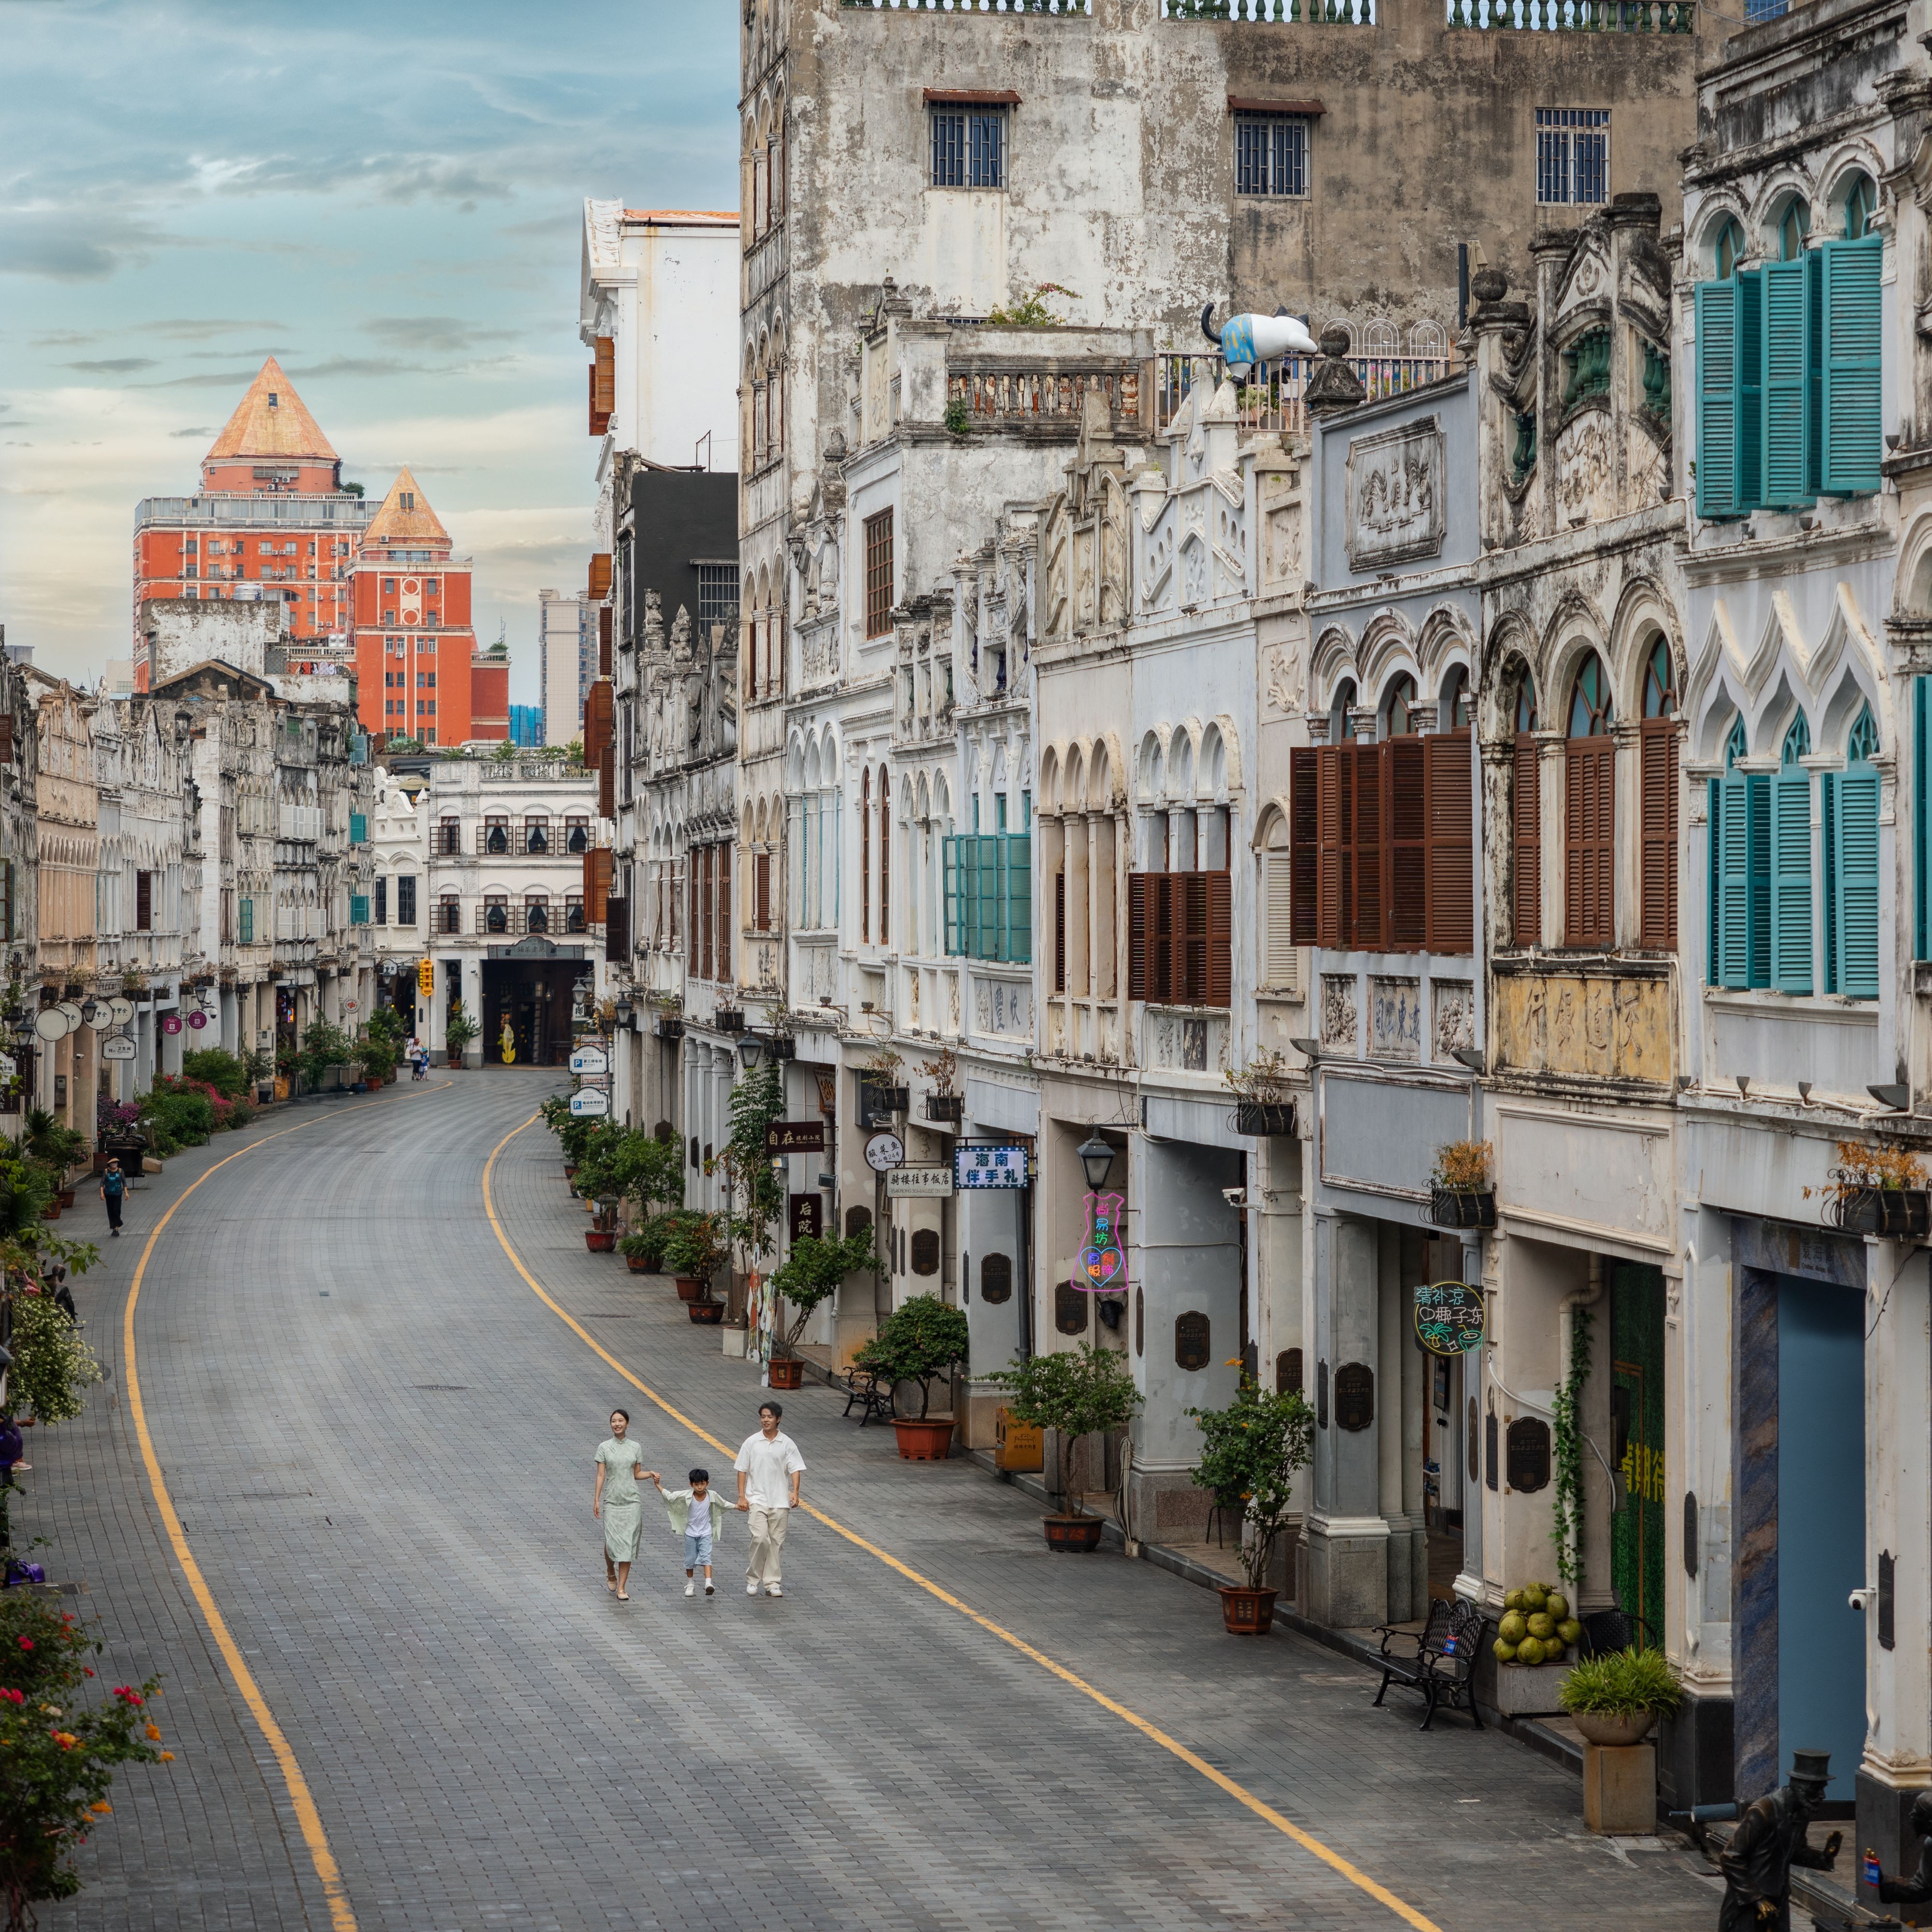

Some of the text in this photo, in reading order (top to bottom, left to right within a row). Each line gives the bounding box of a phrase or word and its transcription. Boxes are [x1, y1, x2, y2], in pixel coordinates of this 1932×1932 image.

[769, 1130, 795, 1146] 自在
[868, 1141, 899, 1158] 酸菜鱼
[975, 1152, 1009, 1166] 海南
[891, 1172, 949, 1185] 骑楼往事饭店
[966, 1168, 1018, 1183] 伴手礼
[798, 1201, 813, 1233] 后院
[1095, 1202, 1108, 1245] 尚易坊
[1088, 1252, 1114, 1264] 原创
[1088, 1264, 1114, 1277] 服饰
[1416, 1286, 1465, 1305] 清补凉
[1435, 1306, 1483, 1324] 椰子冻
